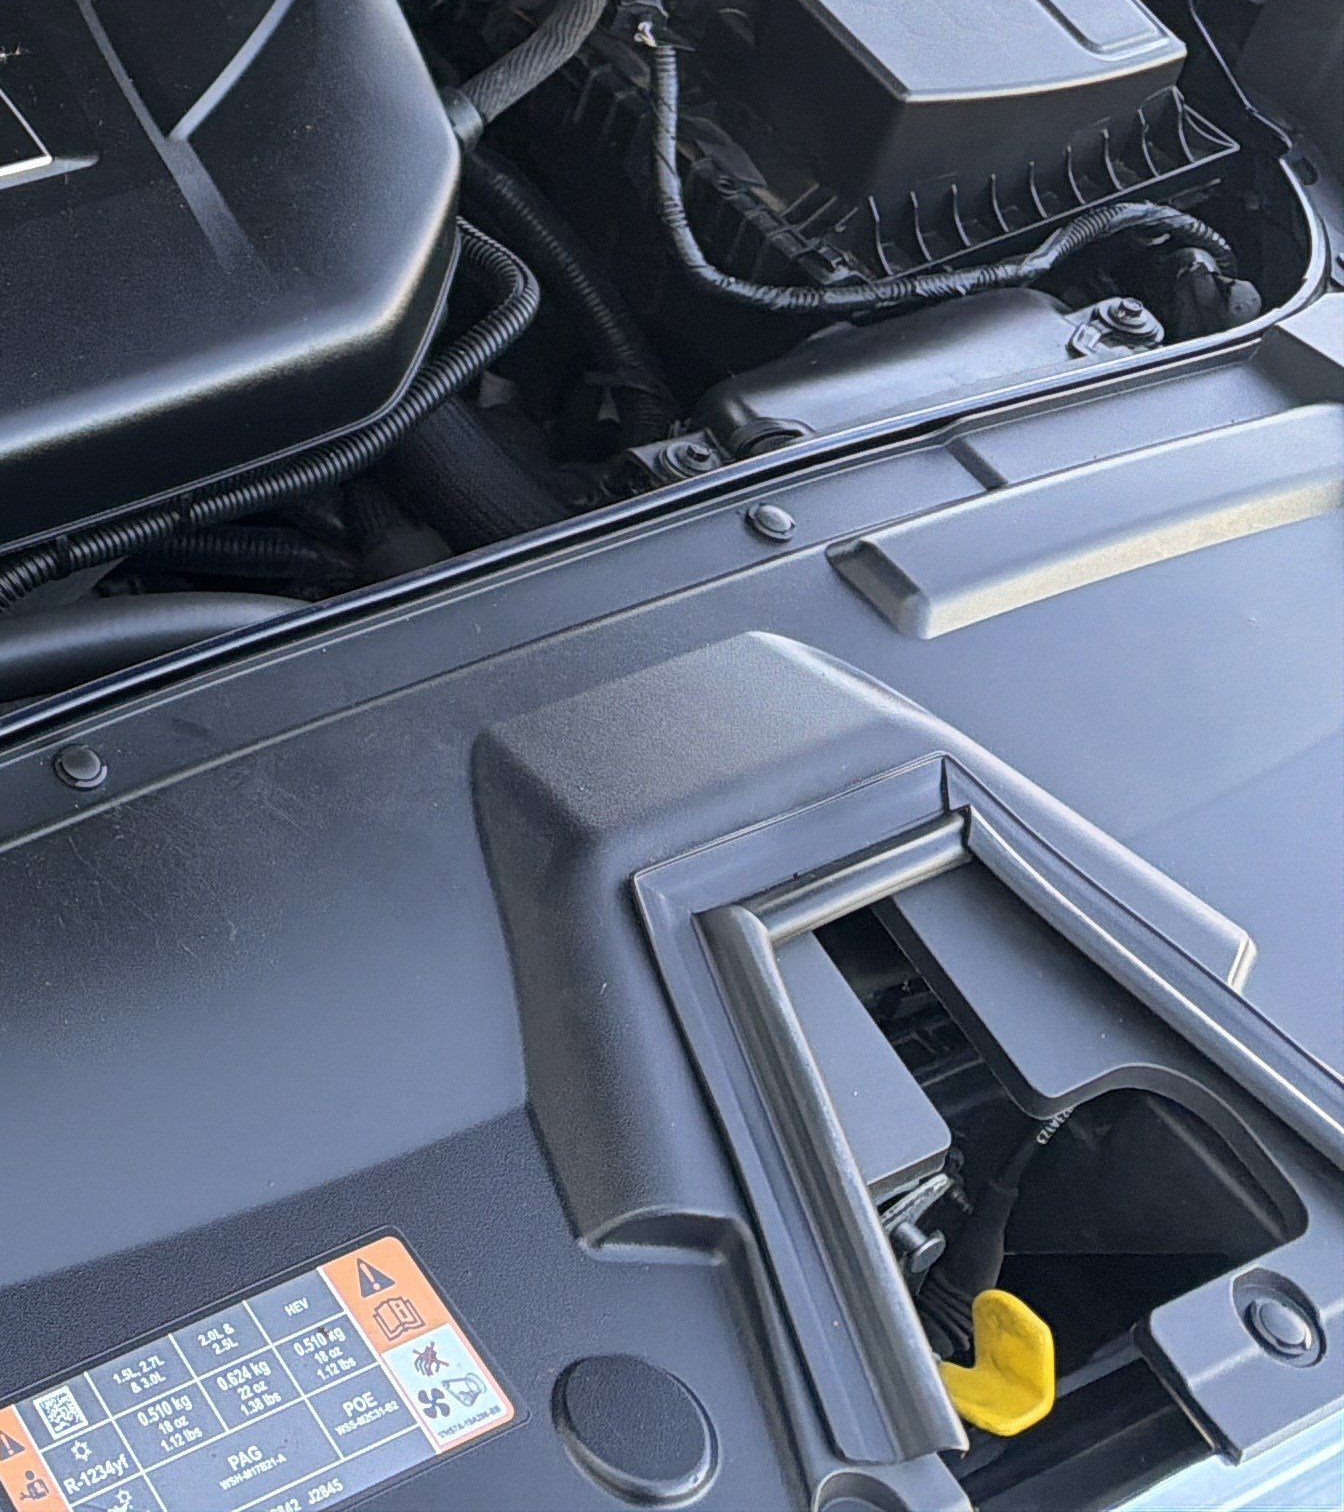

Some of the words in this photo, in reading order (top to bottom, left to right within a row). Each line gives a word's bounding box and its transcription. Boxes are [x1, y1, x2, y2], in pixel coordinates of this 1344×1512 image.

[284, 1296, 309, 1317] HEV
[197, 1328, 225, 1347] 2.0L
[222, 1322, 236, 1335] &
[211, 1336, 240, 1356] 2.5L
[292, 1332, 328, 1357] 0.510
[325, 1326, 347, 1343] kg
[138, 1354, 166, 1374] 2.7L
[313, 1350, 329, 1365] 18
[328, 1346, 344, 1359] oz
[215, 1364, 253, 1392] 0.624
[248, 1360, 272, 1377] kg
[316, 1362, 341, 1381] 1.12
[336, 1356, 357, 1371] lbs
[130, 1380, 143, 1394] &
[139, 1370, 167, 1389] 3.0L
[236, 1384, 255, 1401] 22
[252, 1380, 269, 1394] oz
[137, 1400, 173, 1427] 0.510
[170, 1394, 193, 1411] kg
[240, 1397, 265, 1417] 1.38
[261, 1392, 282, 1407] lbs
[342, 1390, 379, 1418] POE
[158, 1419, 174, 1435] 18
[173, 1415, 190, 1429] oz
[160, 1432, 186, 1452] 1.12
[182, 1427, 204, 1443] lbs
[226, 1444, 263, 1472] PAG
[62, 1452, 130, 1495] R-1234yf
[307, 1477, 345, 1505] J2845
